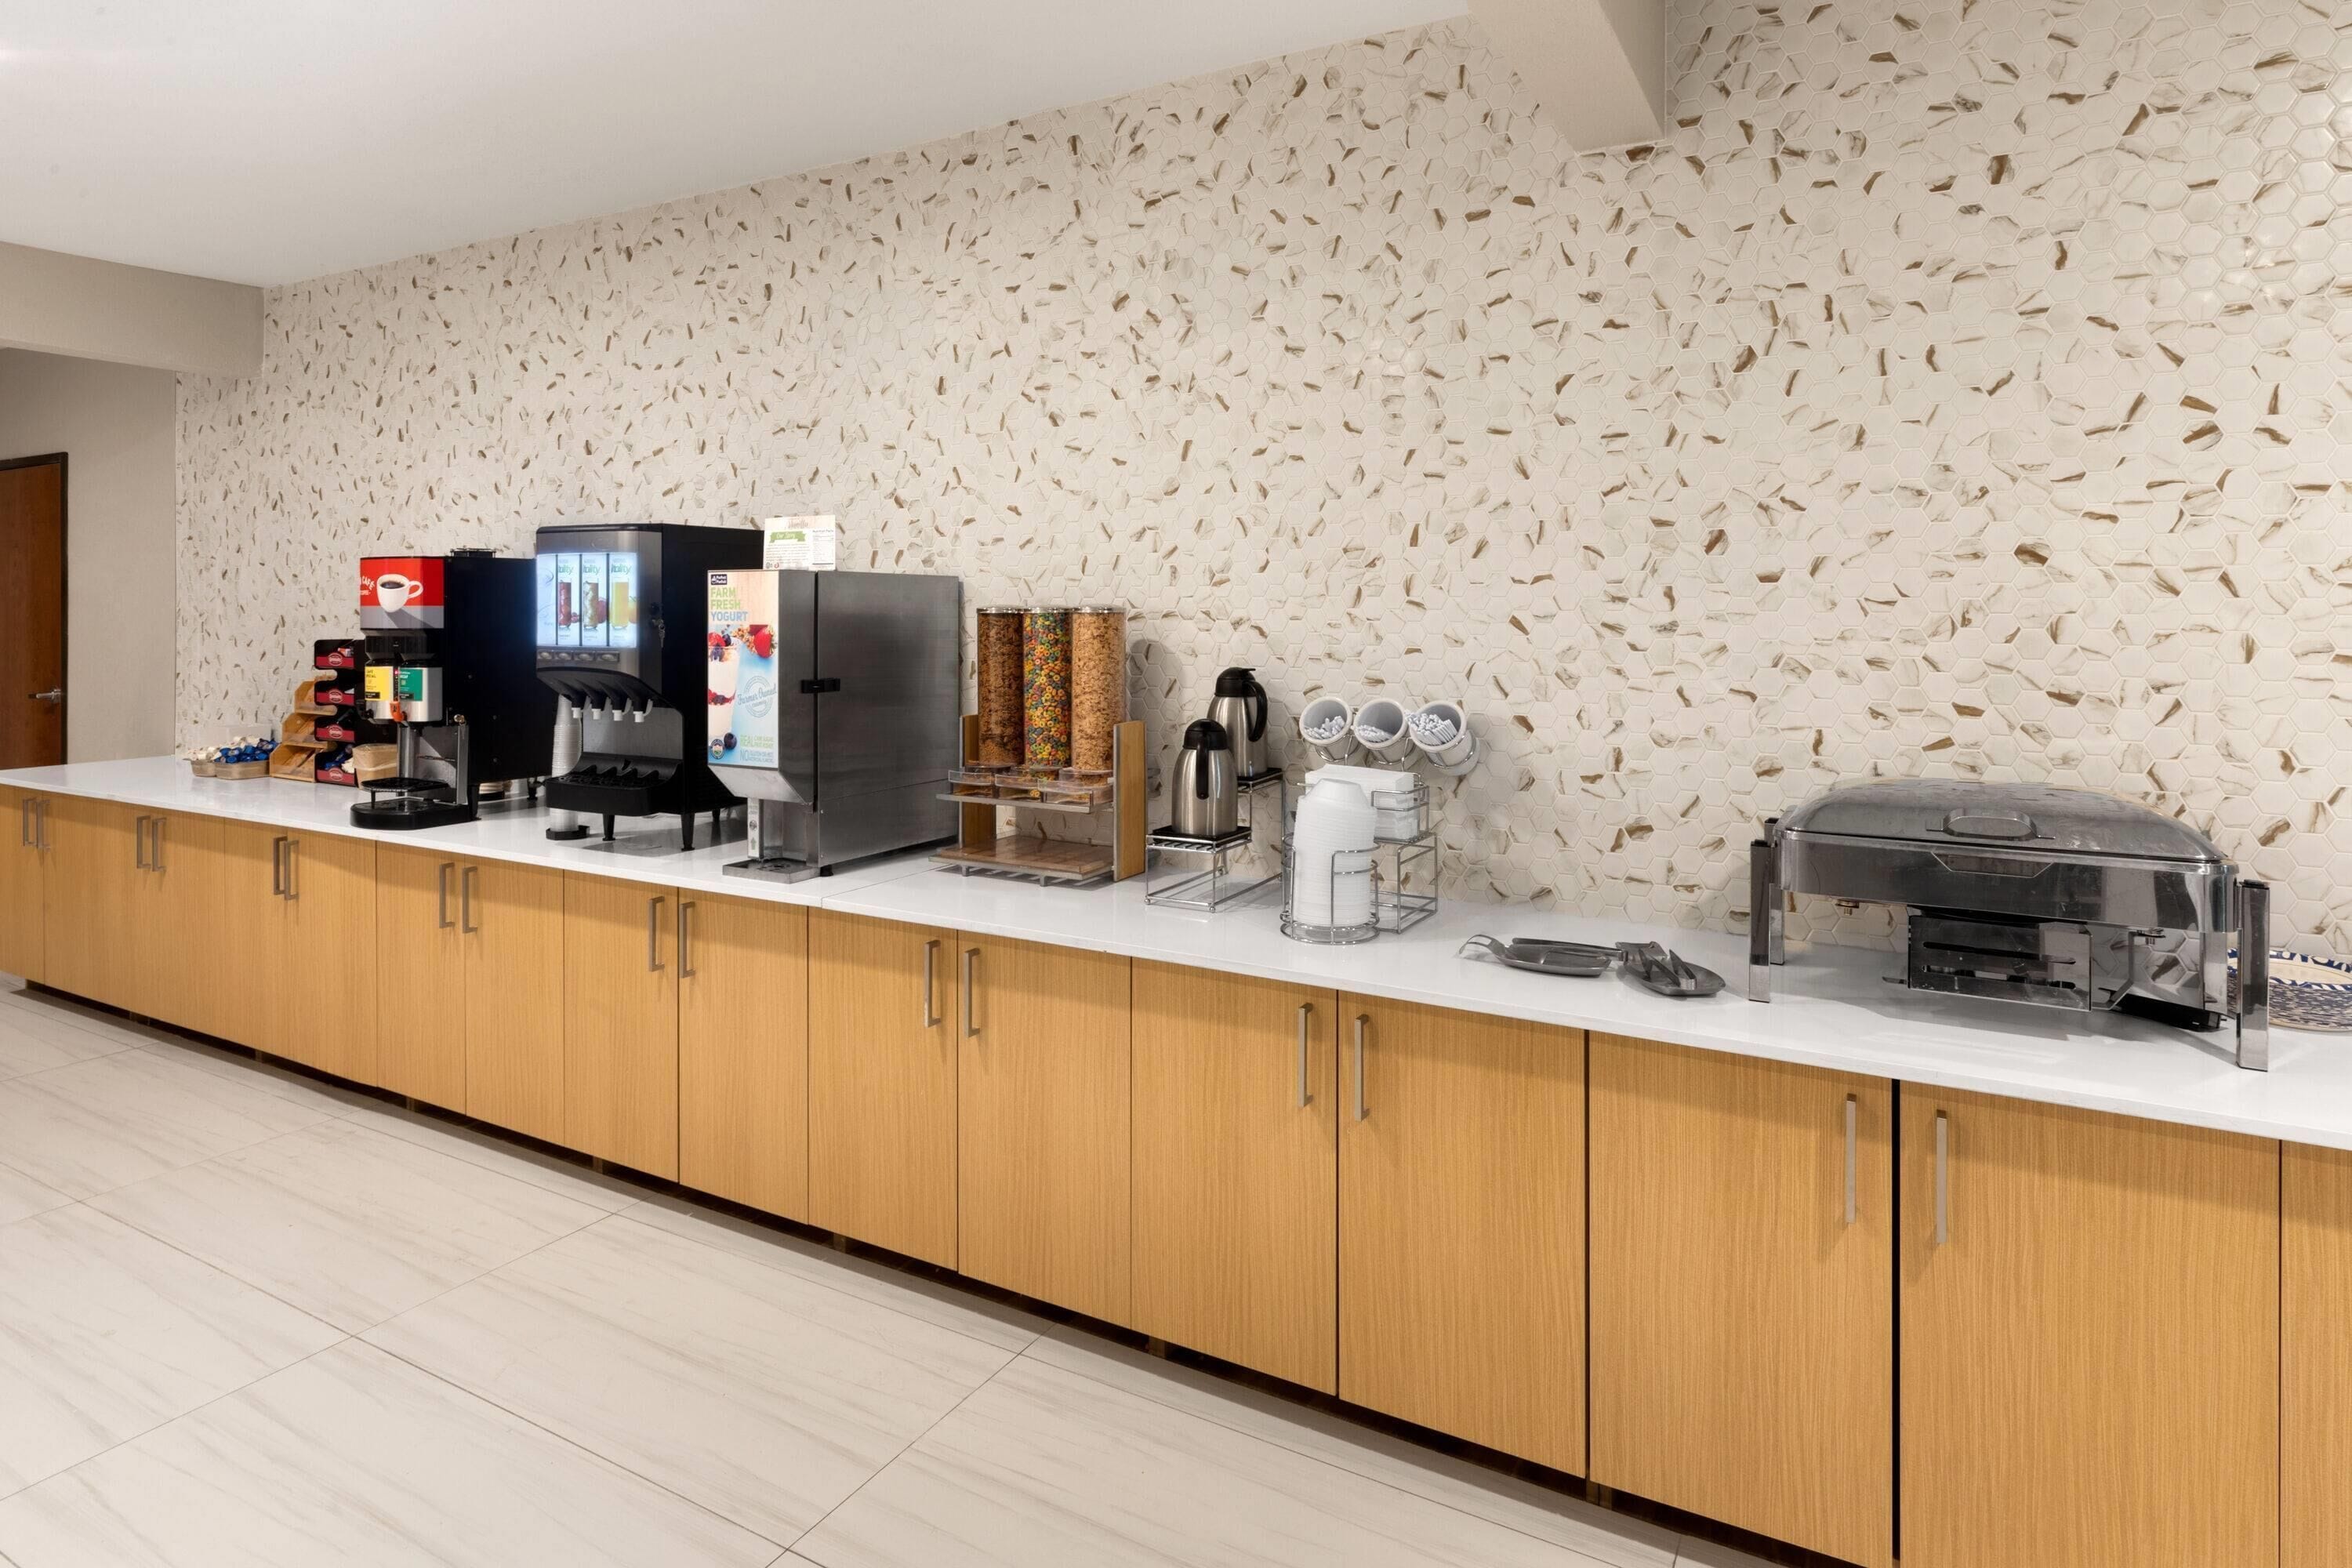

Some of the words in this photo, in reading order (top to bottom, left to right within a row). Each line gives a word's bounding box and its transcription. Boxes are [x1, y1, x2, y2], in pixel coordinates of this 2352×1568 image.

[711, 587, 736, 597] FARM
[711, 599, 741, 610] FRESH
[711, 611, 748, 621] YOGURT
[737, 692, 758, 705] Farmer
[758, 683, 777, 698] Owned
[740, 750, 750, 761] NO
